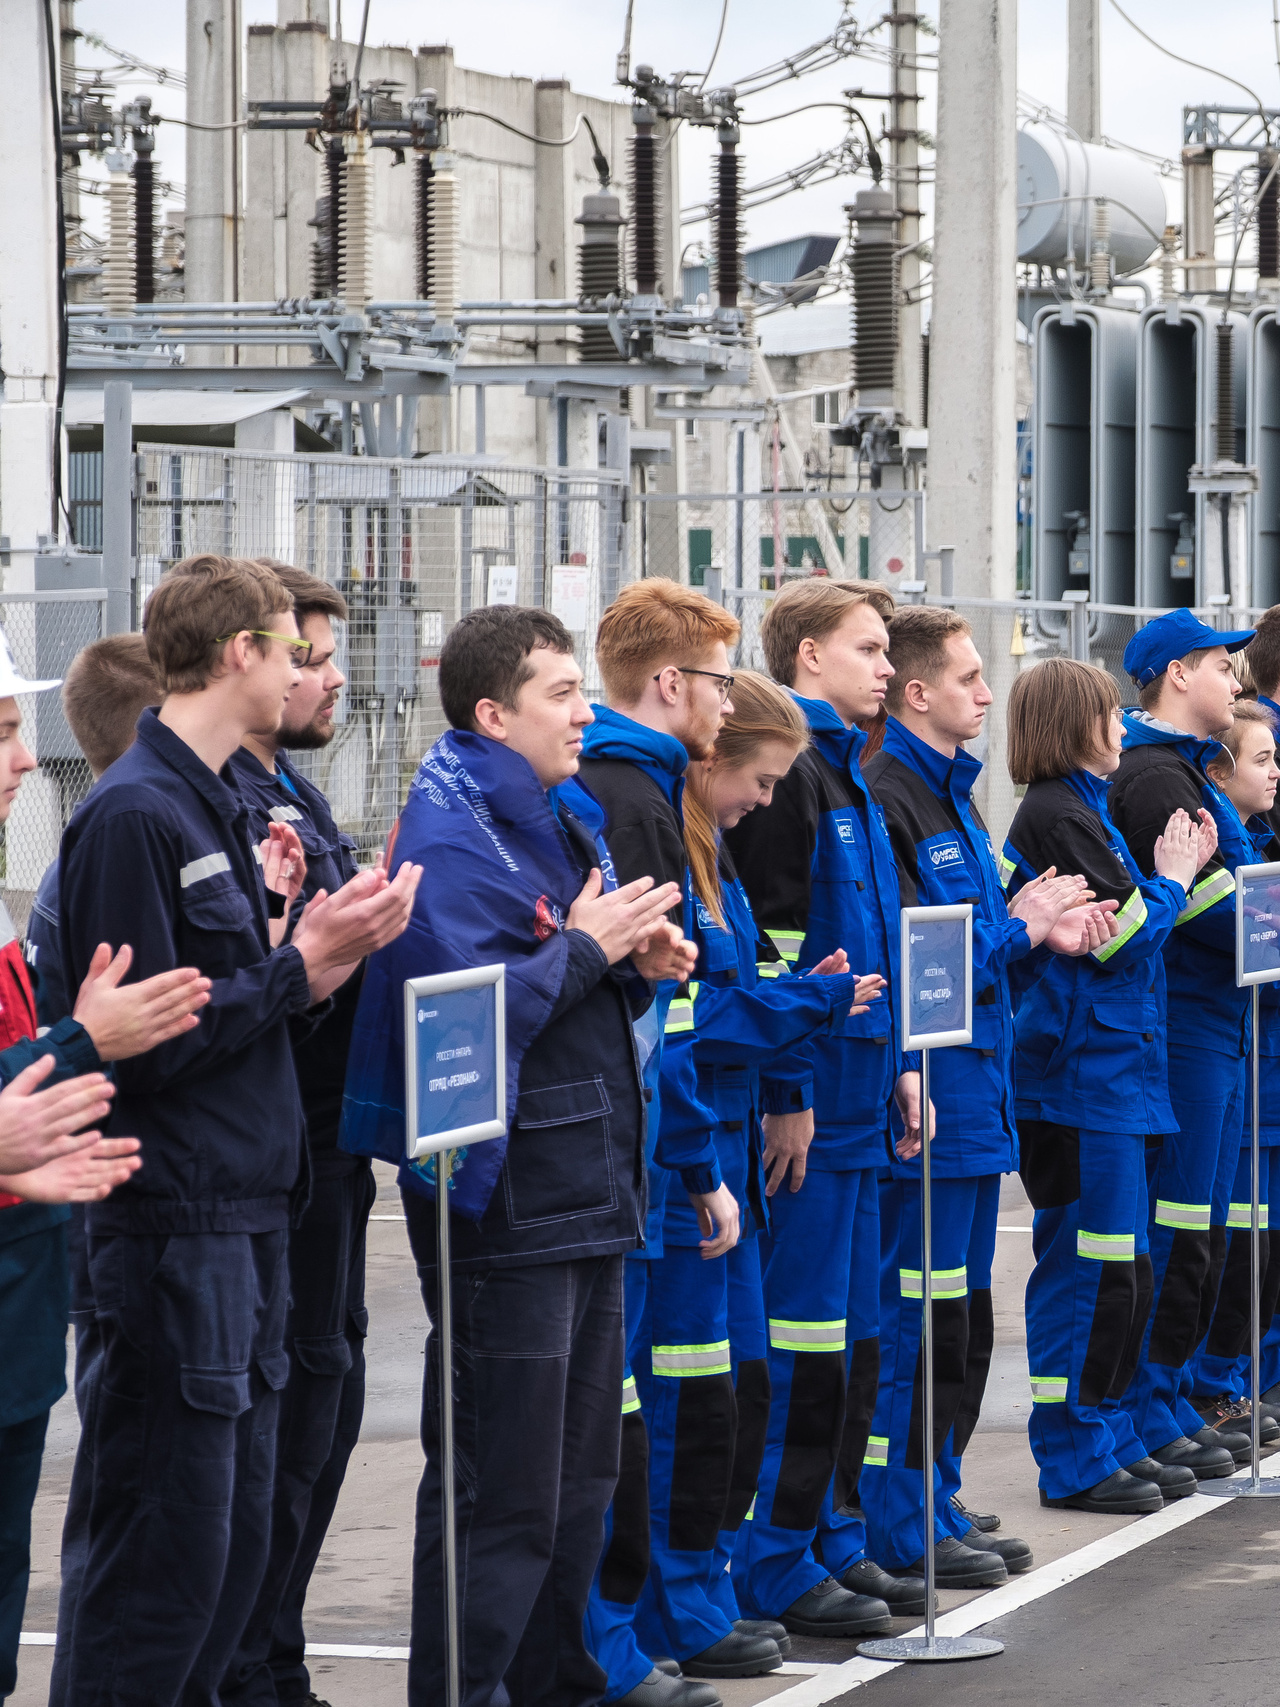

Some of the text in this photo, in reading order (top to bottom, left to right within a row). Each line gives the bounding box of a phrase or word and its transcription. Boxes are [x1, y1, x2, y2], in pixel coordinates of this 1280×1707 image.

[939, 847, 958, 856] МРСК
[941, 853, 960, 862] УРАЛА
[428, 1077, 447, 1091] ОТРЯД
